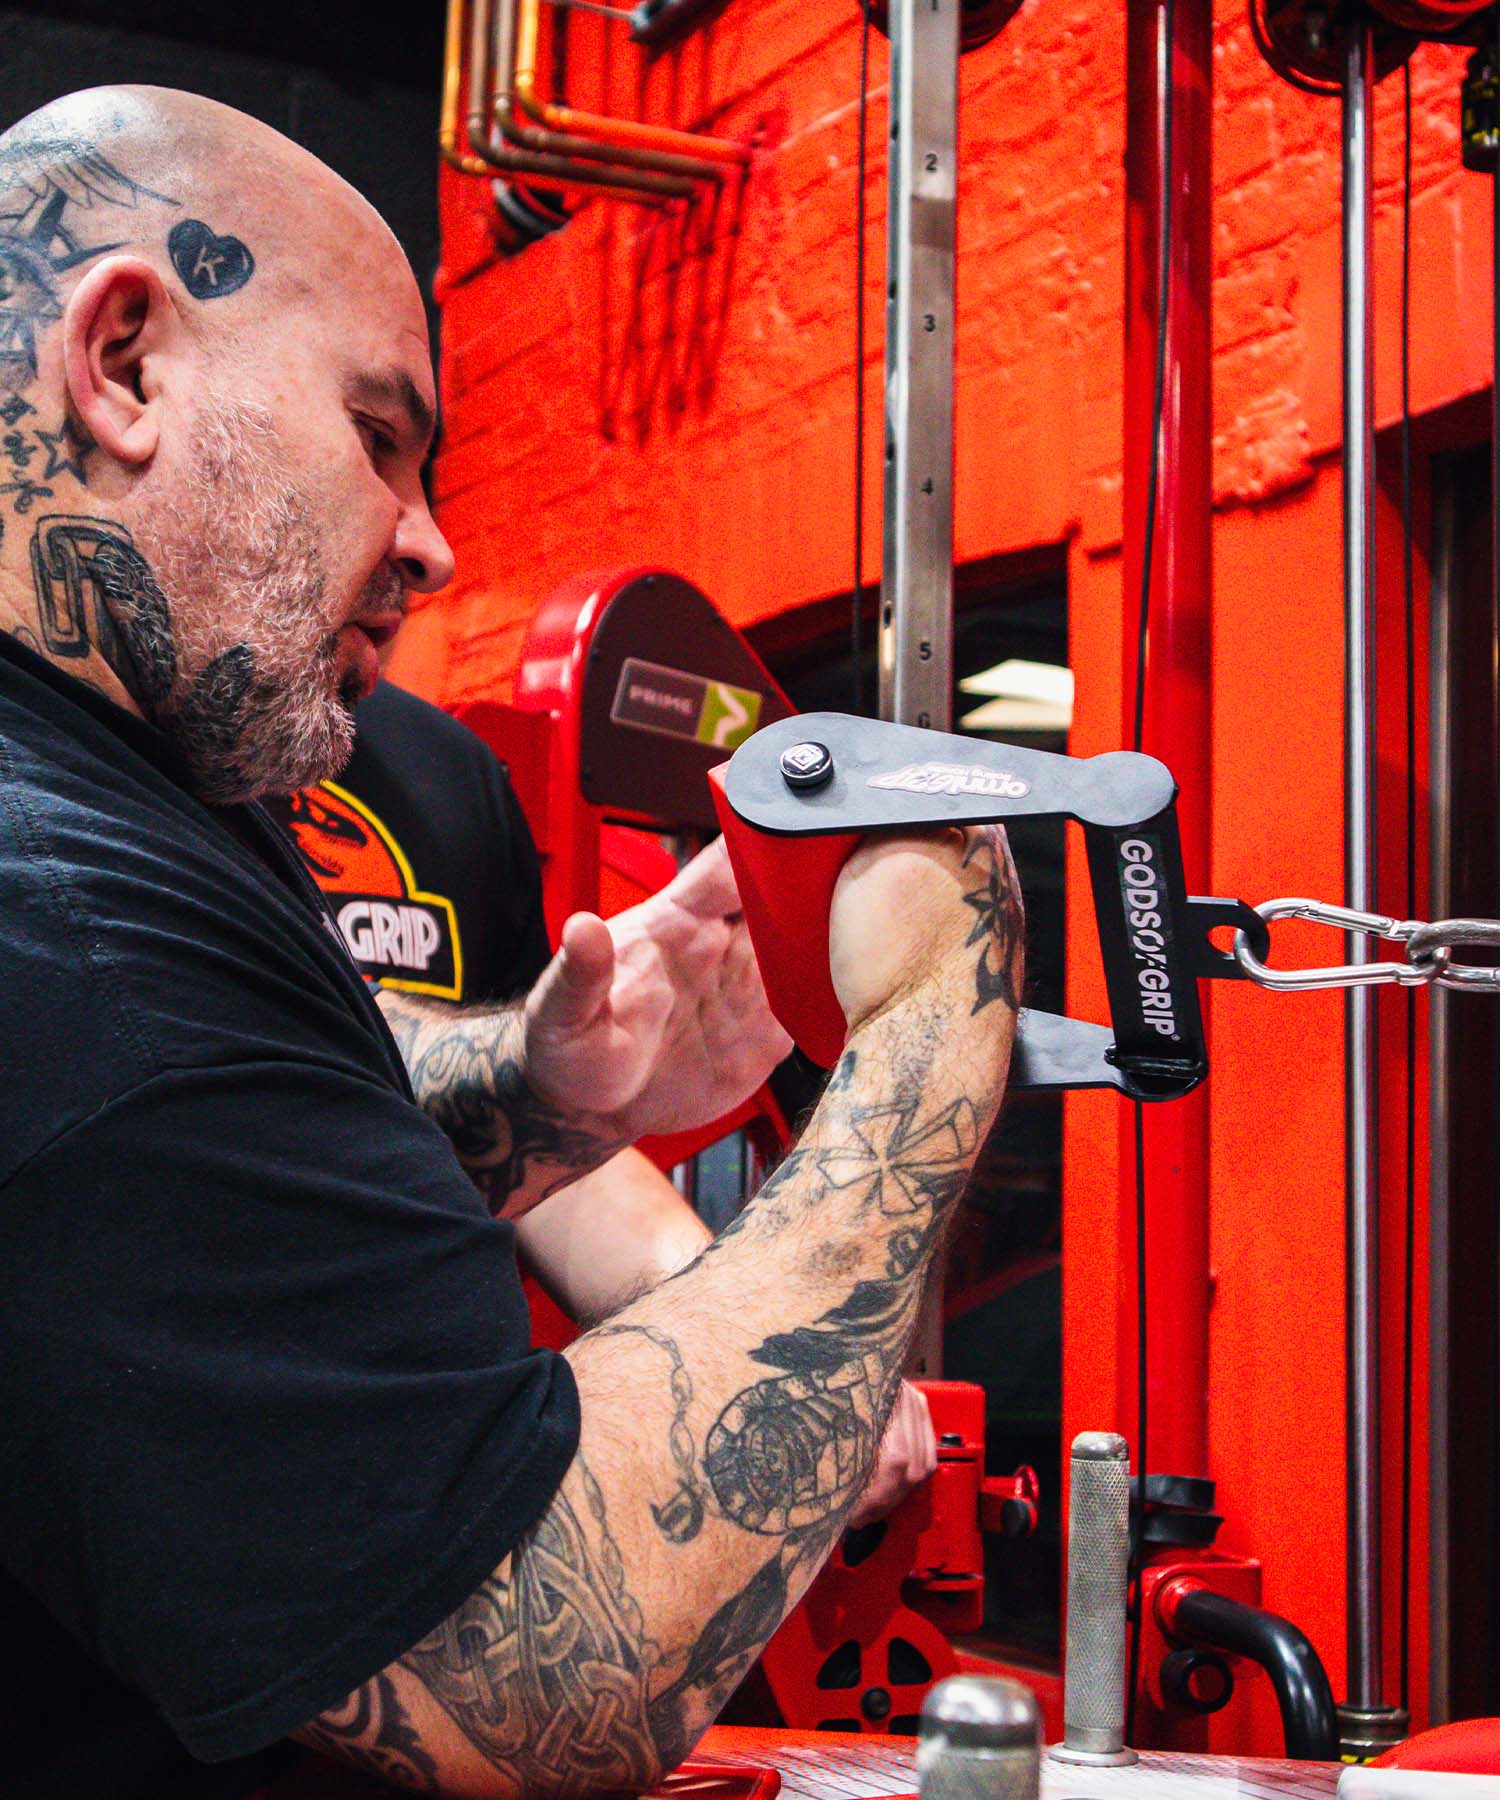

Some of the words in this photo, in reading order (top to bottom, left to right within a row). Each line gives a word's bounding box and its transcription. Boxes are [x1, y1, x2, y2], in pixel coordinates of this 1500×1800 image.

[926, 153, 937, 172] 2
[924, 315, 936, 332] 3
[921, 476, 933, 496] 4
[920, 642, 931, 660] 5
[336, 901, 440, 970] GRIP
